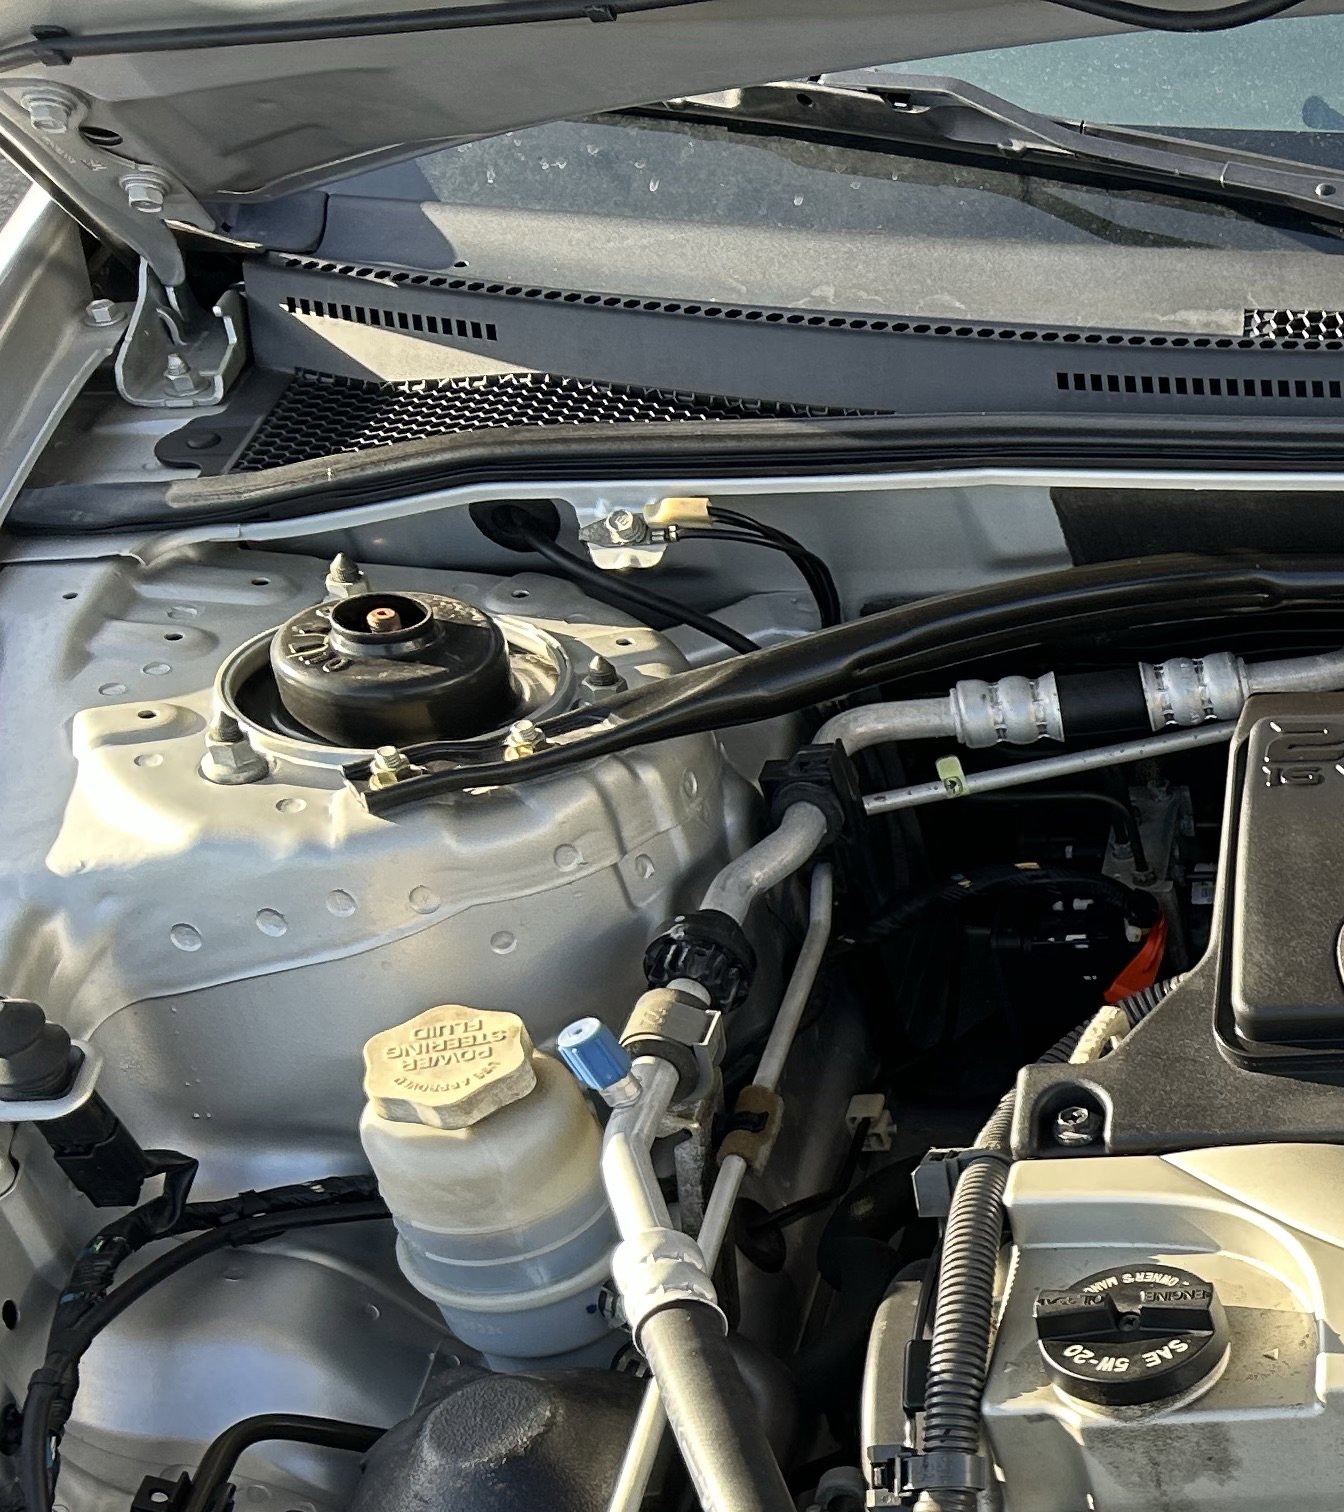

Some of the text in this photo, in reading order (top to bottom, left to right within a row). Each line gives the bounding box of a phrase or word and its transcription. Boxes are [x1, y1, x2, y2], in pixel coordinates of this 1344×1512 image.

[1262, 765, 1326, 787] 16
[413, 1019, 484, 1041] FLUID
[386, 1029, 508, 1060] STEERING
[402, 1046, 493, 1072] POWER
[1121, 1271, 1180, 1288] OWNER'S
[1144, 1288, 1207, 1302] ENGINE
[1063, 1339, 1190, 1373] SAE 5W-20
